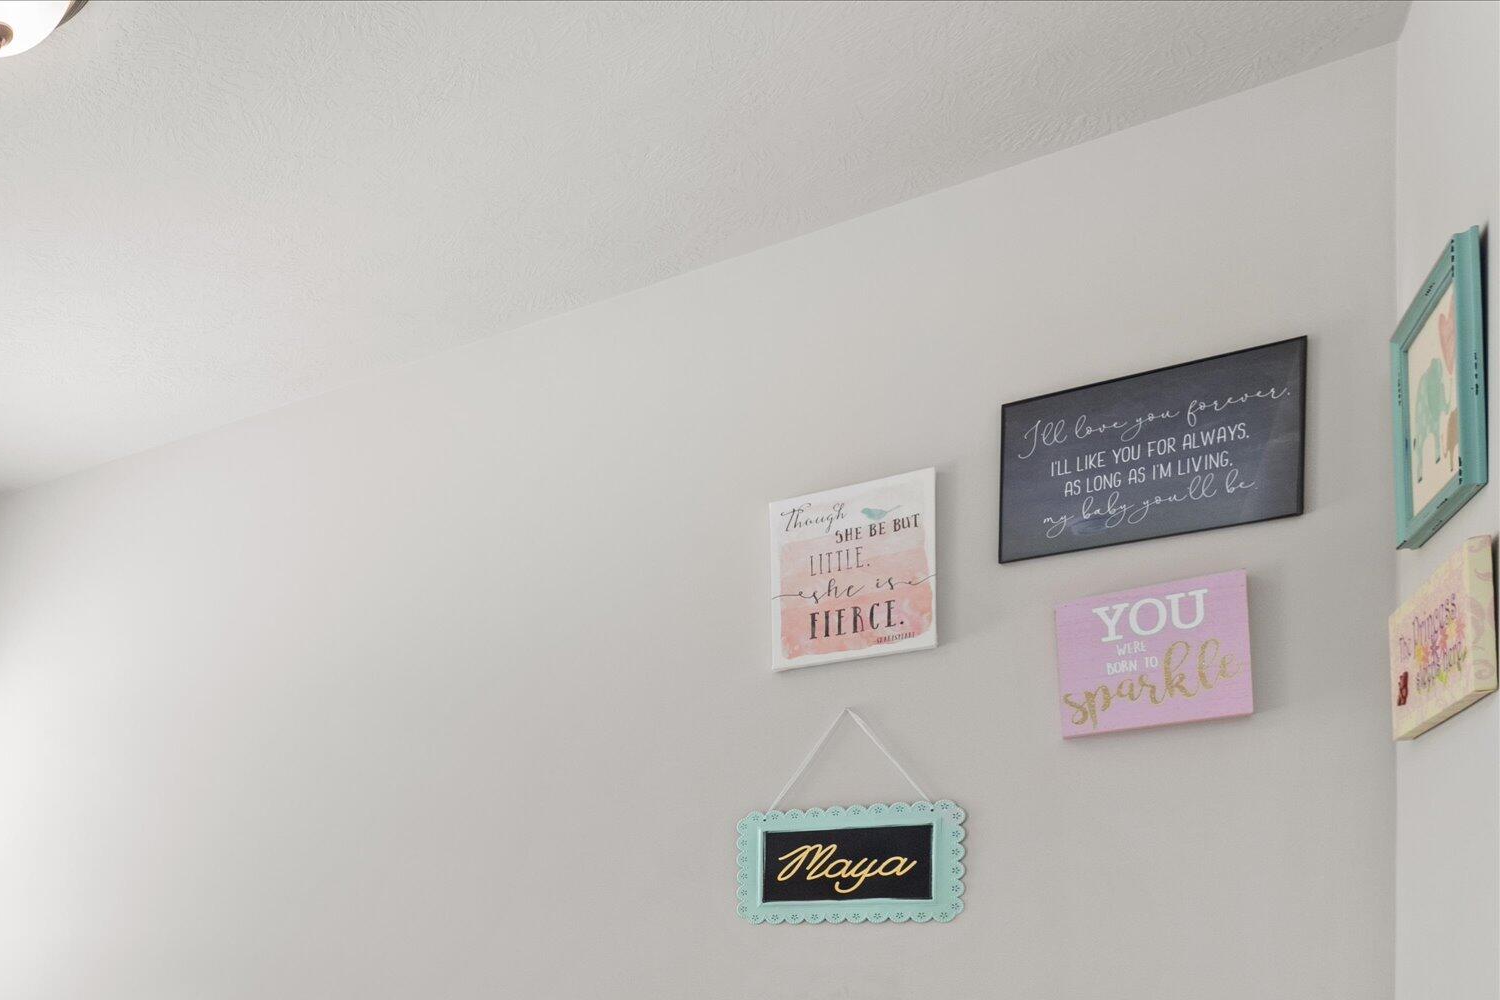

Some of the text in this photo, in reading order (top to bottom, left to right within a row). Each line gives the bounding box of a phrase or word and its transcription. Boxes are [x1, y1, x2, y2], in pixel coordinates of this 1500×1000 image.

[1075, 415, 1128, 439] love
[1121, 411, 1180, 442] you
[1187, 387, 1291, 427] forever.
[1051, 422, 1250, 477] I'LL LIKE YOU FOR ALWAYS.
[1064, 450, 1233, 497] AS LONG AS I'M LIVING.
[780, 503, 847, 533] Though
[835, 513, 920, 544] SHE BE BUT
[1043, 514, 1075, 539] my
[1081, 490, 1134, 528] baby
[809, 546, 870, 577] LITTLE.
[792, 578, 865, 604] she
[809, 599, 904, 640] FIERCE.
[1092, 588, 1209, 642] YOU
[1106, 656, 1159, 676] BORN TO
[1116, 640, 1148, 656] WERE
[1062, 638, 1243, 730] sparkle
[777, 843, 917, 895] Maya
